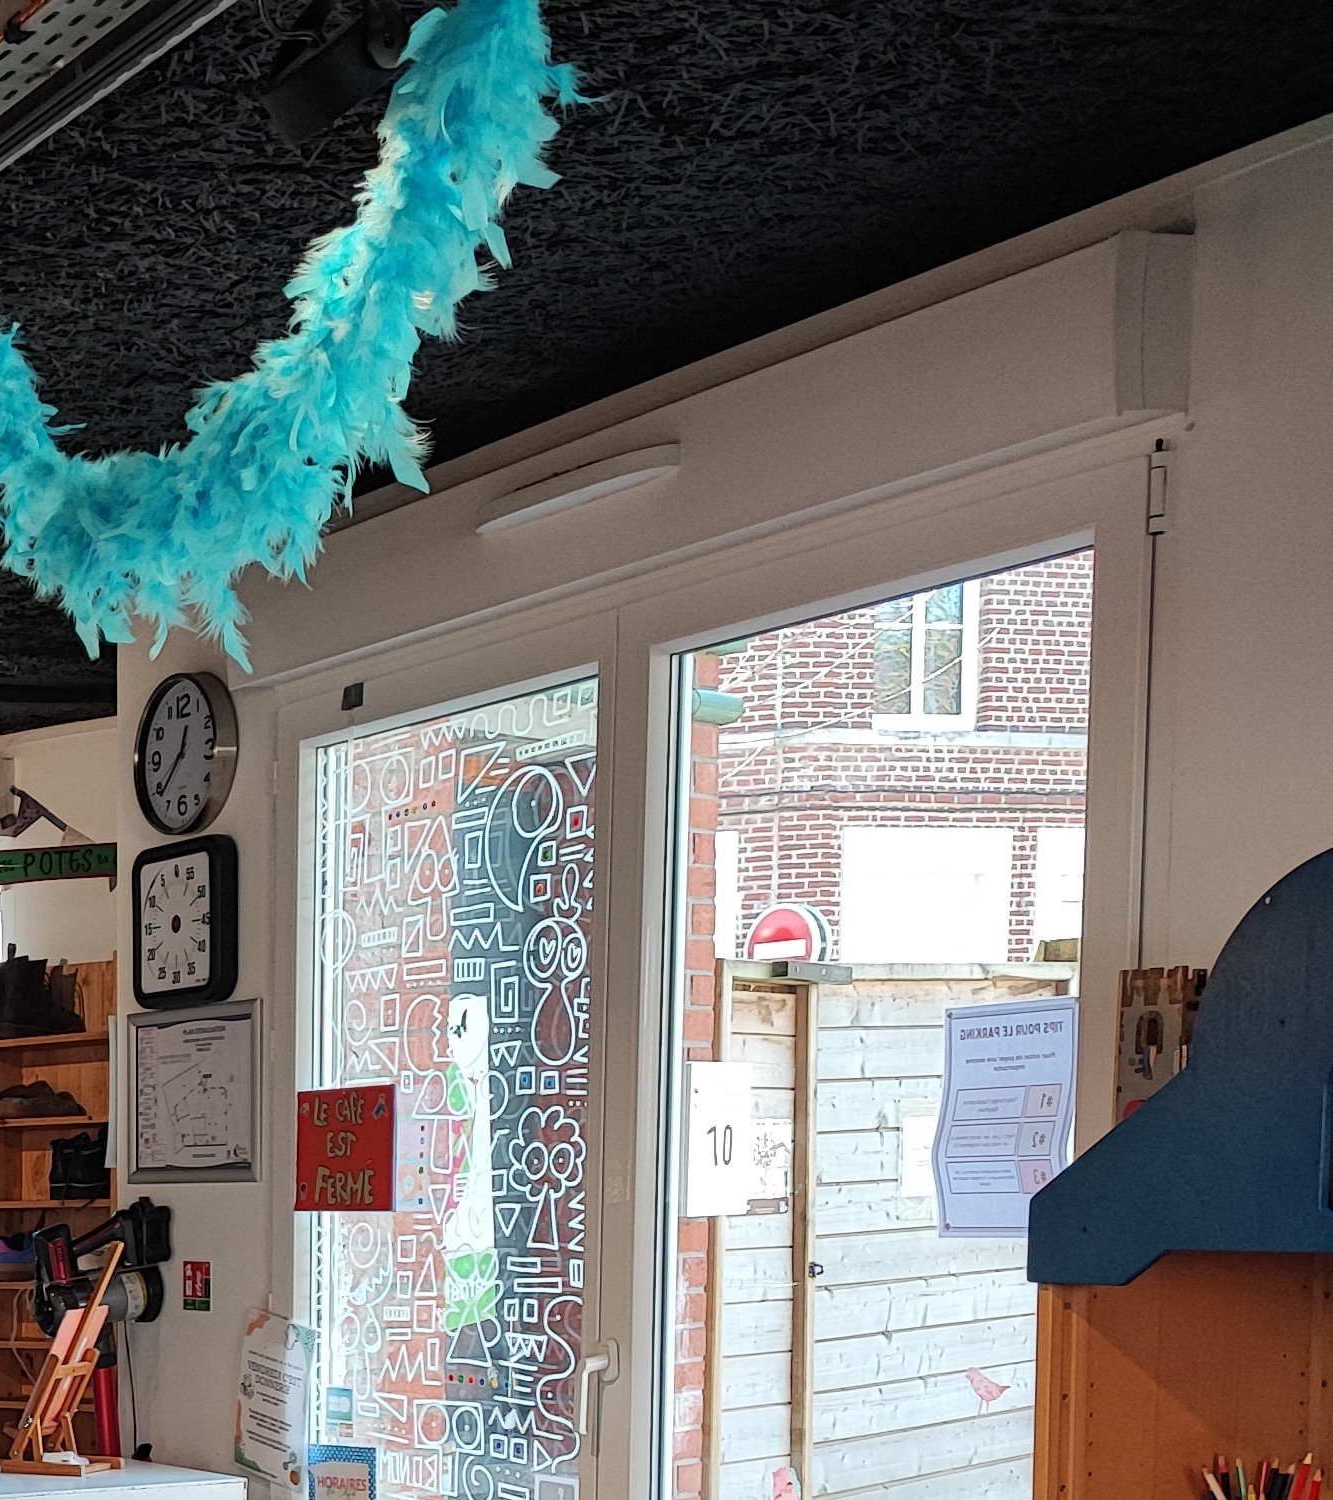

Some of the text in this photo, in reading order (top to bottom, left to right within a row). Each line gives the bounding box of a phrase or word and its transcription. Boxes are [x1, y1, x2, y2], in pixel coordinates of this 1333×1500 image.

[176, 693, 191, 719] 12
[196, 698, 200, 712] 1
[204, 715, 211, 730] 2
[155, 726, 165, 741] 10
[203, 738, 215, 760] 3
[151, 750, 162, 772] 9
[203, 772, 211, 782] 4
[155, 782, 163, 795] 8
[165, 800, 171, 812] 7
[177, 794, 188, 816] 6
[194, 794, 201, 806] 5
[23, 849, 93, 877] POTES
[186, 866, 195, 880] 55
[160, 874, 166, 887] 5
[197, 885, 206, 899] 50
[148, 895, 156, 908] 10
[201, 912, 210, 925] 45
[144, 923, 153, 936] 15
[198, 939, 206, 952] 40
[147, 948, 156, 961] 20
[158, 967, 167, 979] 25
[187, 962, 196, 975] 35
[172, 971, 181, 984] 30
[313, 1096, 328, 1127] LE
[326, 1131, 357, 1158] EST
[707, 1125, 733, 1166] 10
[314, 1159, 375, 1206] FERMÉ
[317, 1475, 367, 1492] HORAIRES
